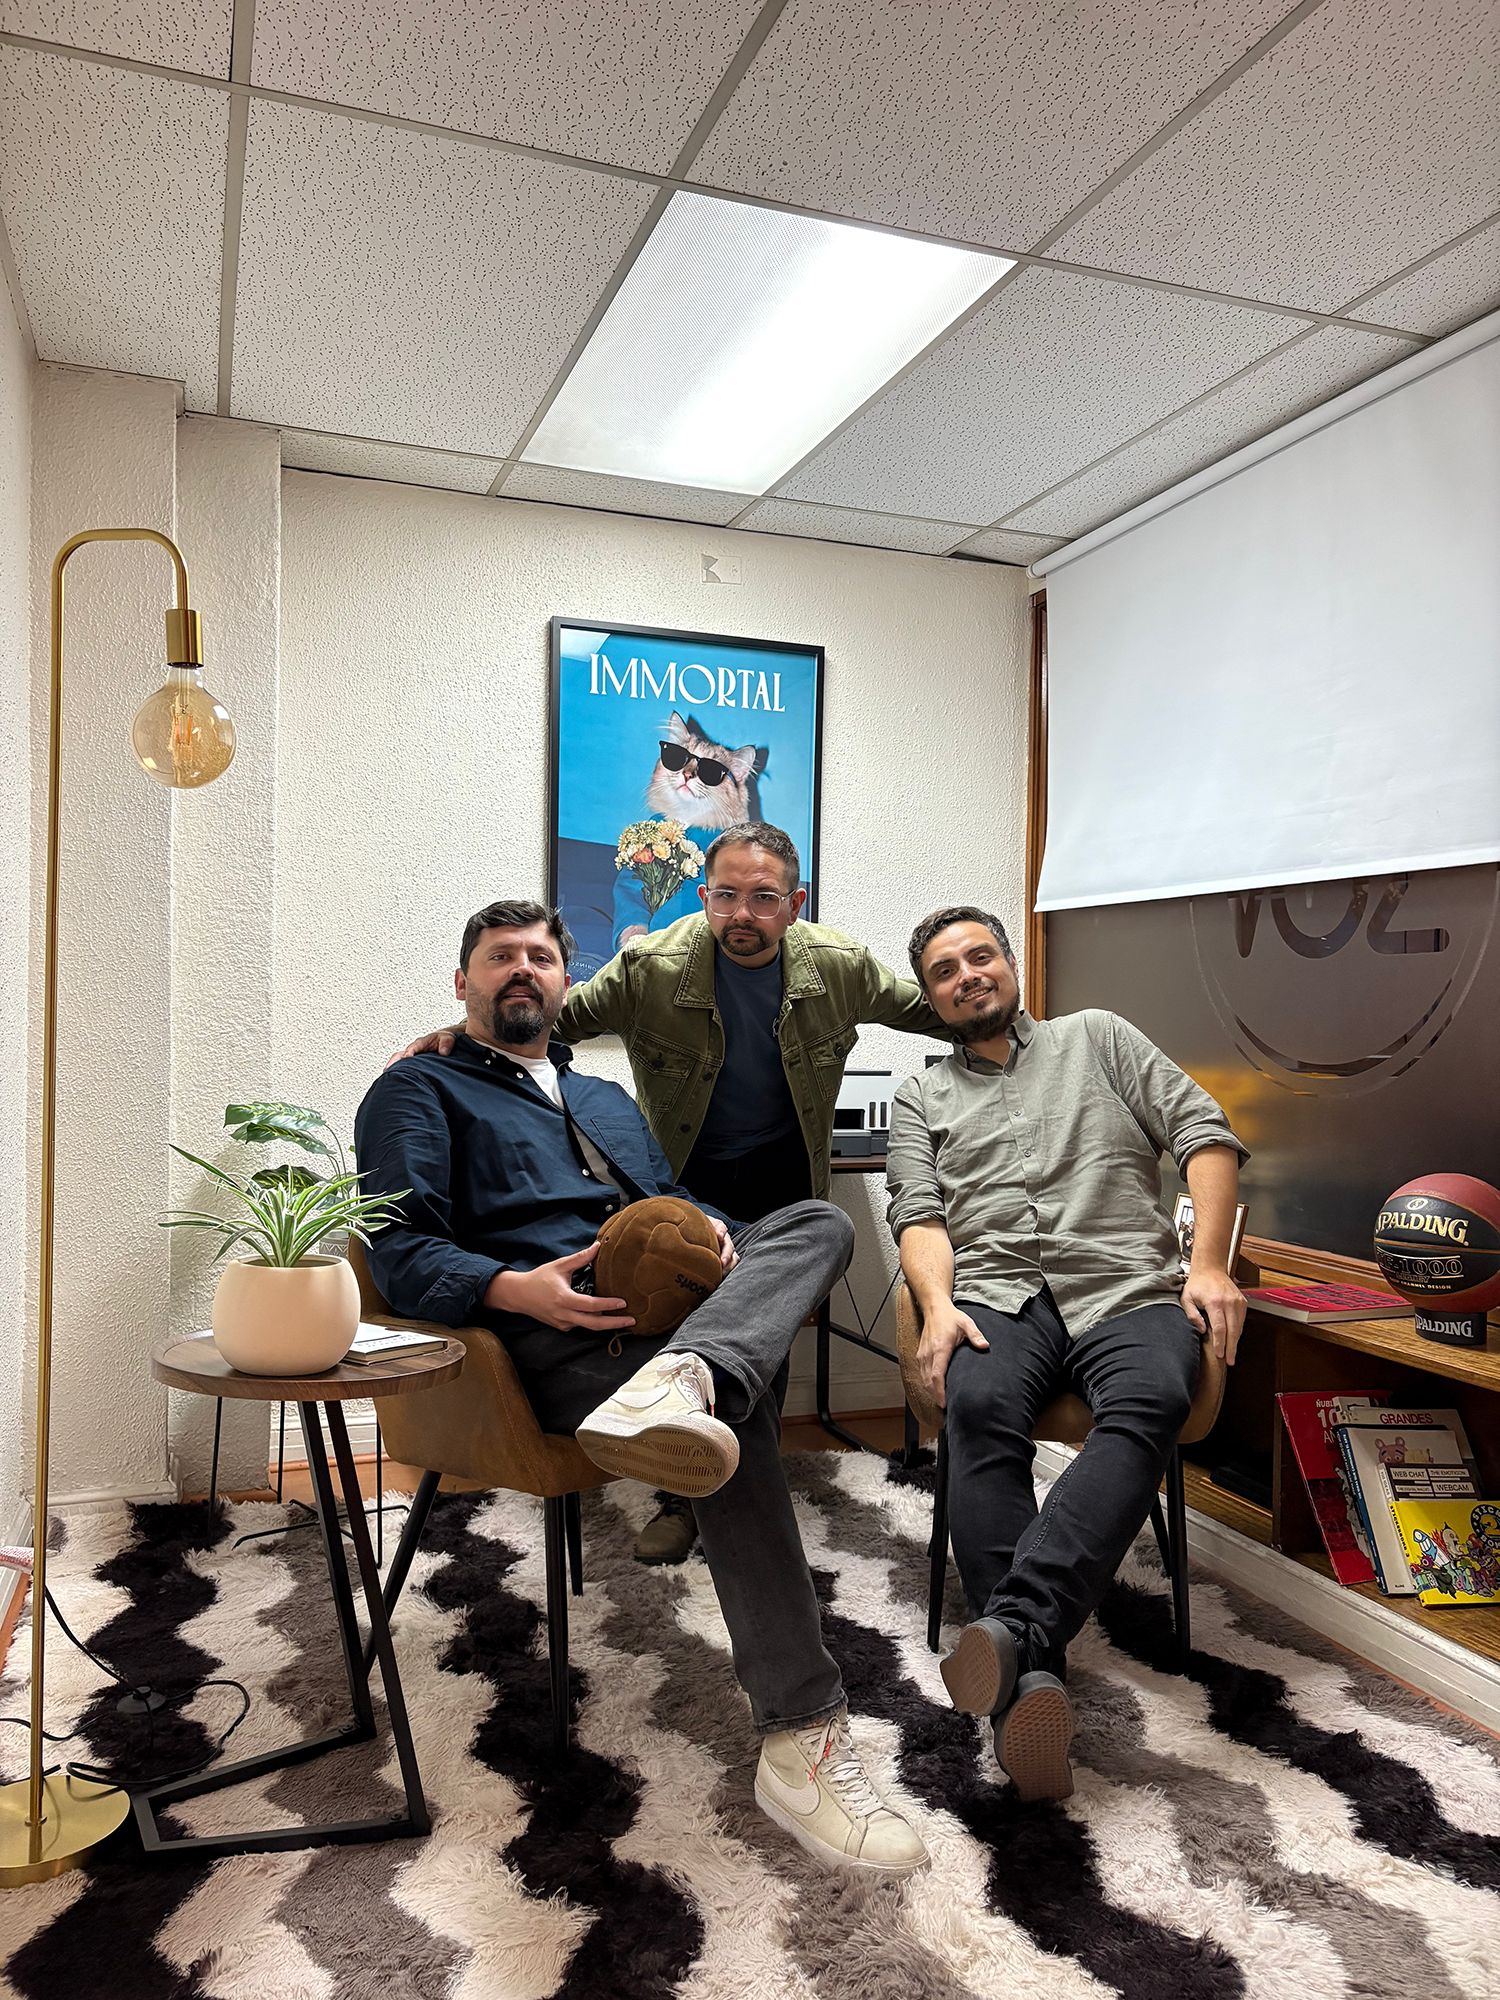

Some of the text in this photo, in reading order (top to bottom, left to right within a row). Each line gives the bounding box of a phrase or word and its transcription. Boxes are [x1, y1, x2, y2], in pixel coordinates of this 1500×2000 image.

[590, 653, 785, 712] IMMORTAL
[1316, 1398, 1334, 1408] ÑUBL
[1317, 1409, 1338, 1428] 10
[1380, 1413, 1434, 1425] GRANDES
[1393, 1470, 1408, 1478] WEB
[1436, 1484, 1469, 1492] WEBCAM
[1472, 1506, 1500, 1520] STICK
